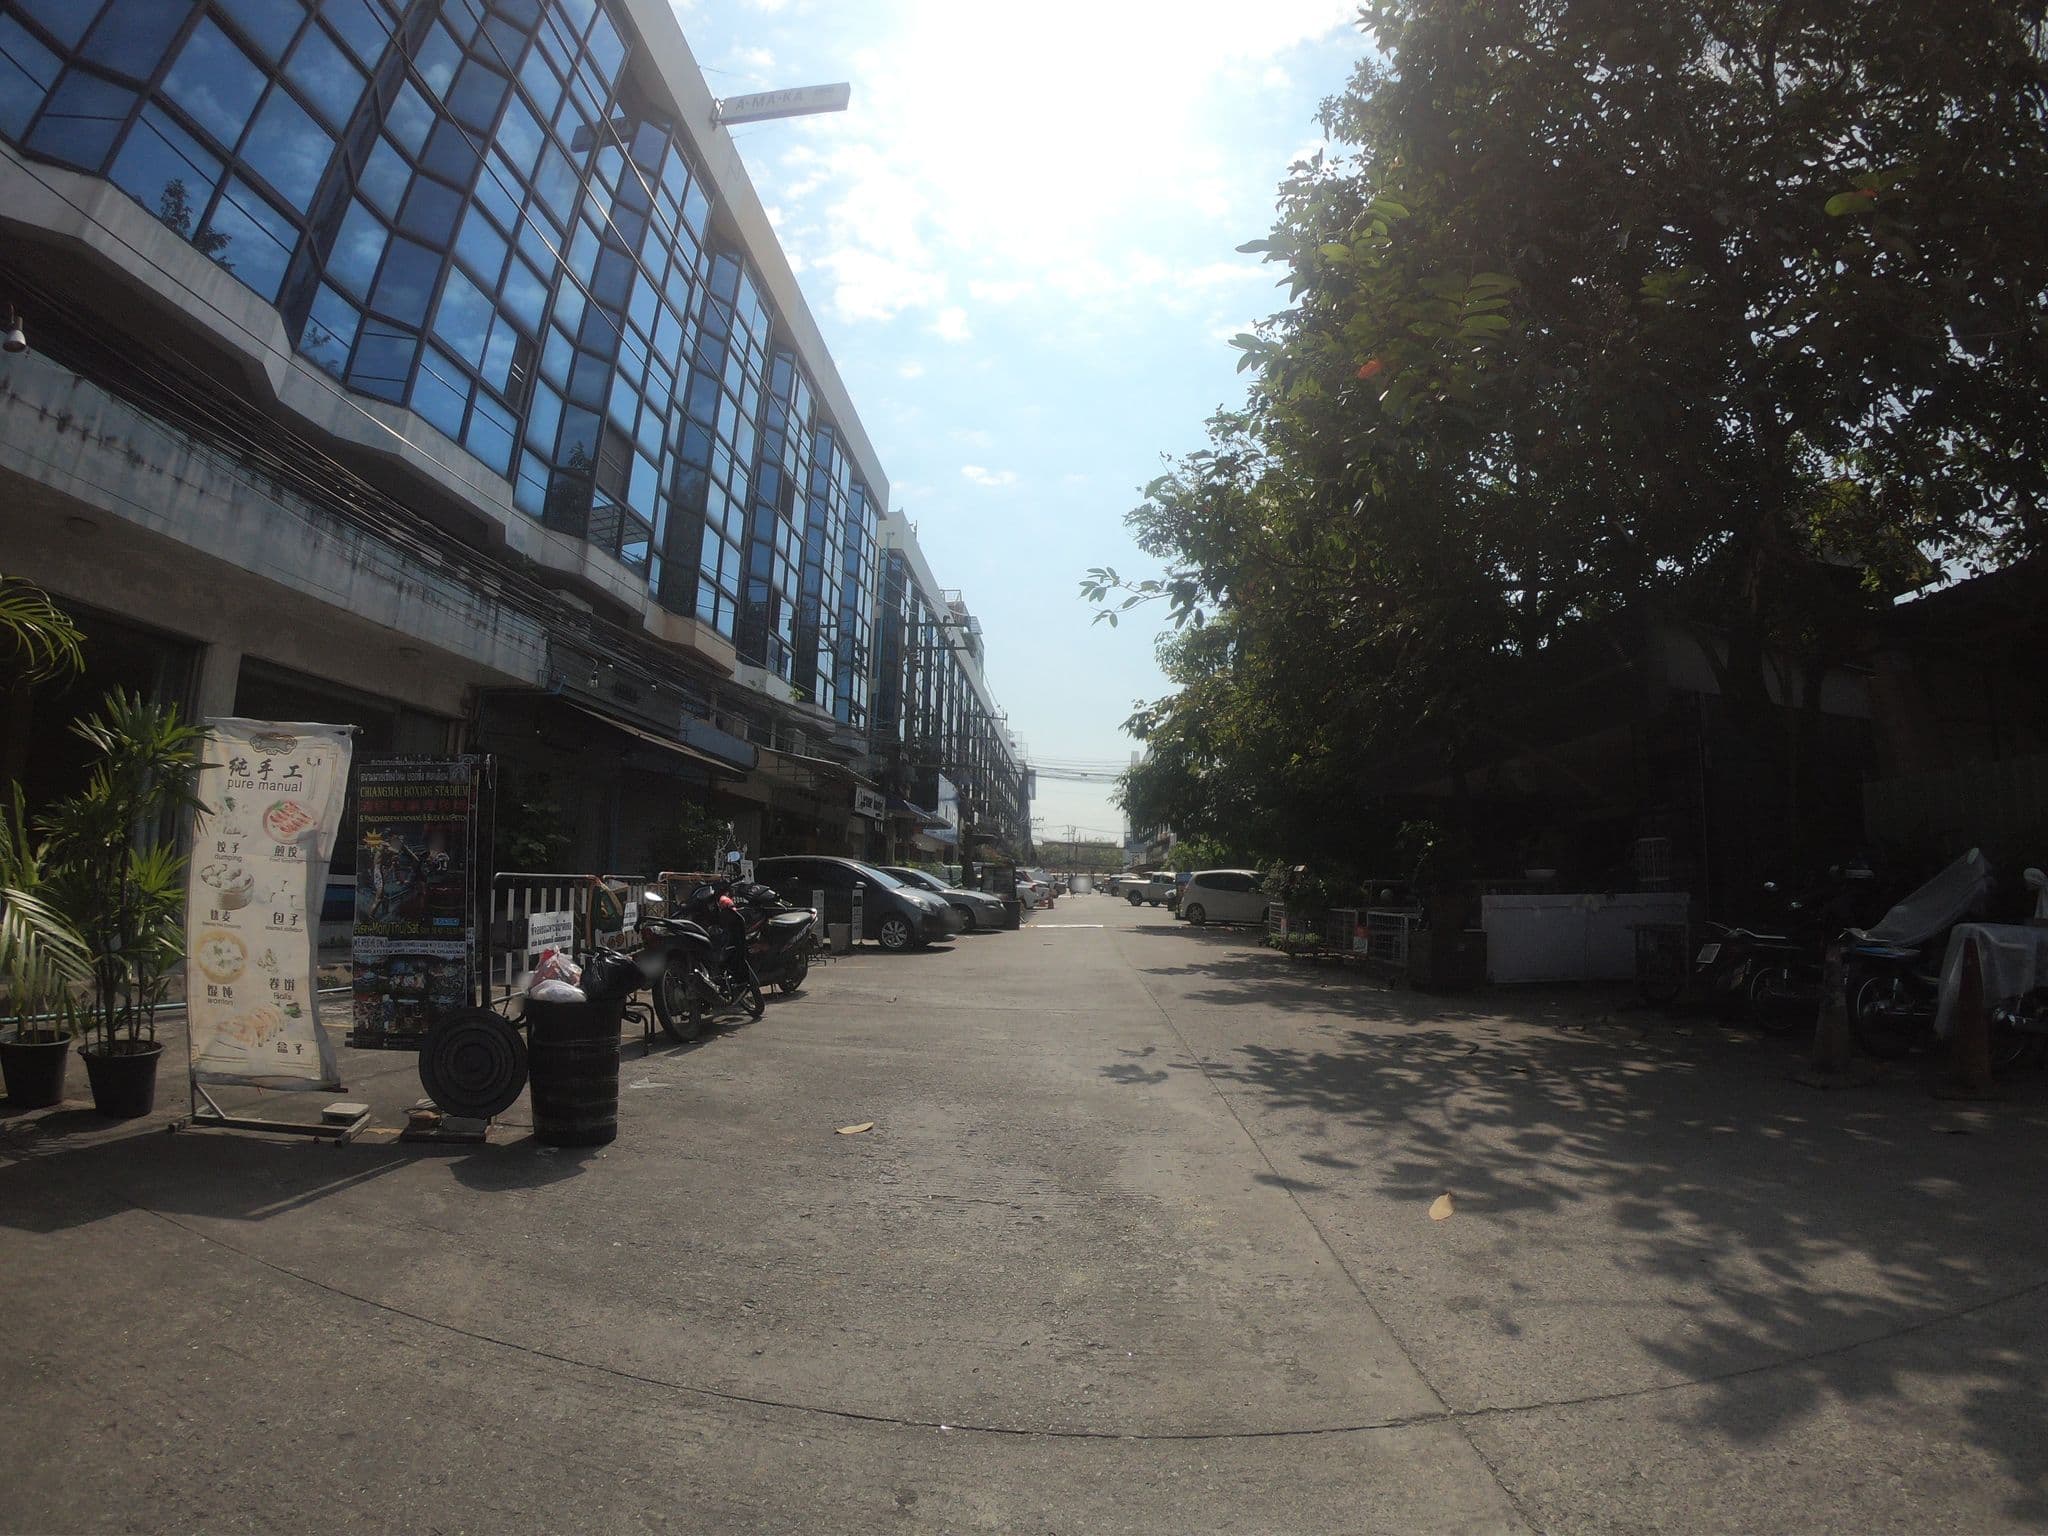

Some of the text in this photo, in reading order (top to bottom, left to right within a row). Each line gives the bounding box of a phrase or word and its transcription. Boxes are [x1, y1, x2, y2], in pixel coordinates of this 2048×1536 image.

[228, 756, 303, 781] 纯手工
[227, 779, 303, 792] pure manual
[273, 911, 299, 926] 包子
